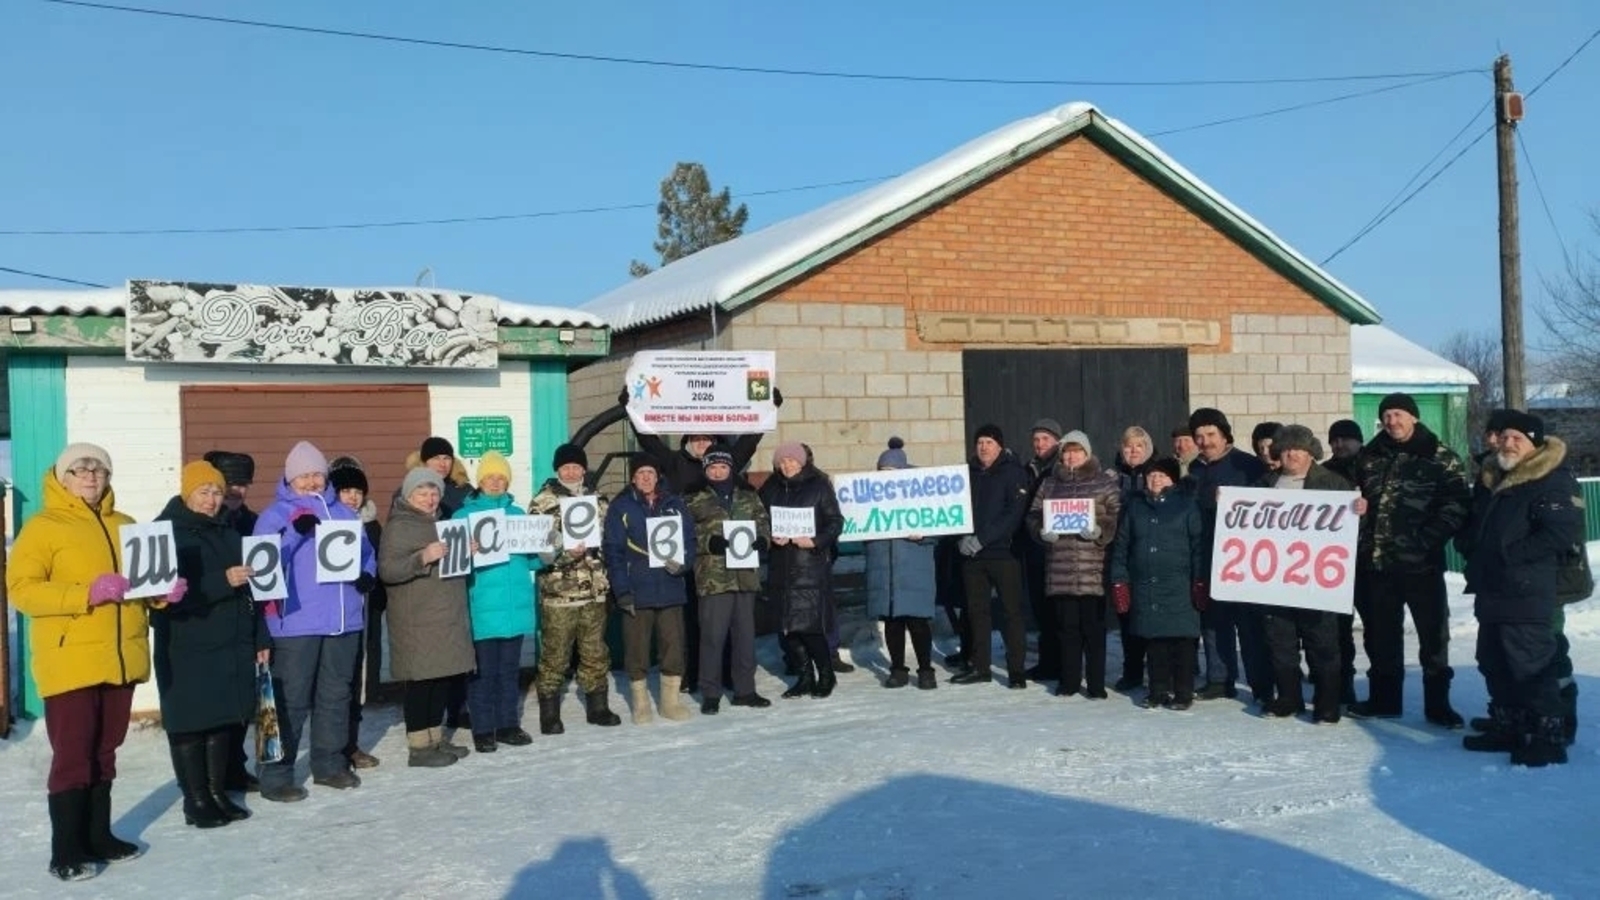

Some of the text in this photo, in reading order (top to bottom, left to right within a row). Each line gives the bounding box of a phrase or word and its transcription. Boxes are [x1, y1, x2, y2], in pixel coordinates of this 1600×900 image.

[201, 294, 448, 347] Для Вас
[687, 379, 715, 389] ППМИ
[691, 392, 715, 401] 2026
[1052, 513, 1090, 530] 2026
[1225, 500, 1347, 532] ППМИ
[506, 519, 550, 532] ППМИ
[1220, 537, 1350, 589] 2026
